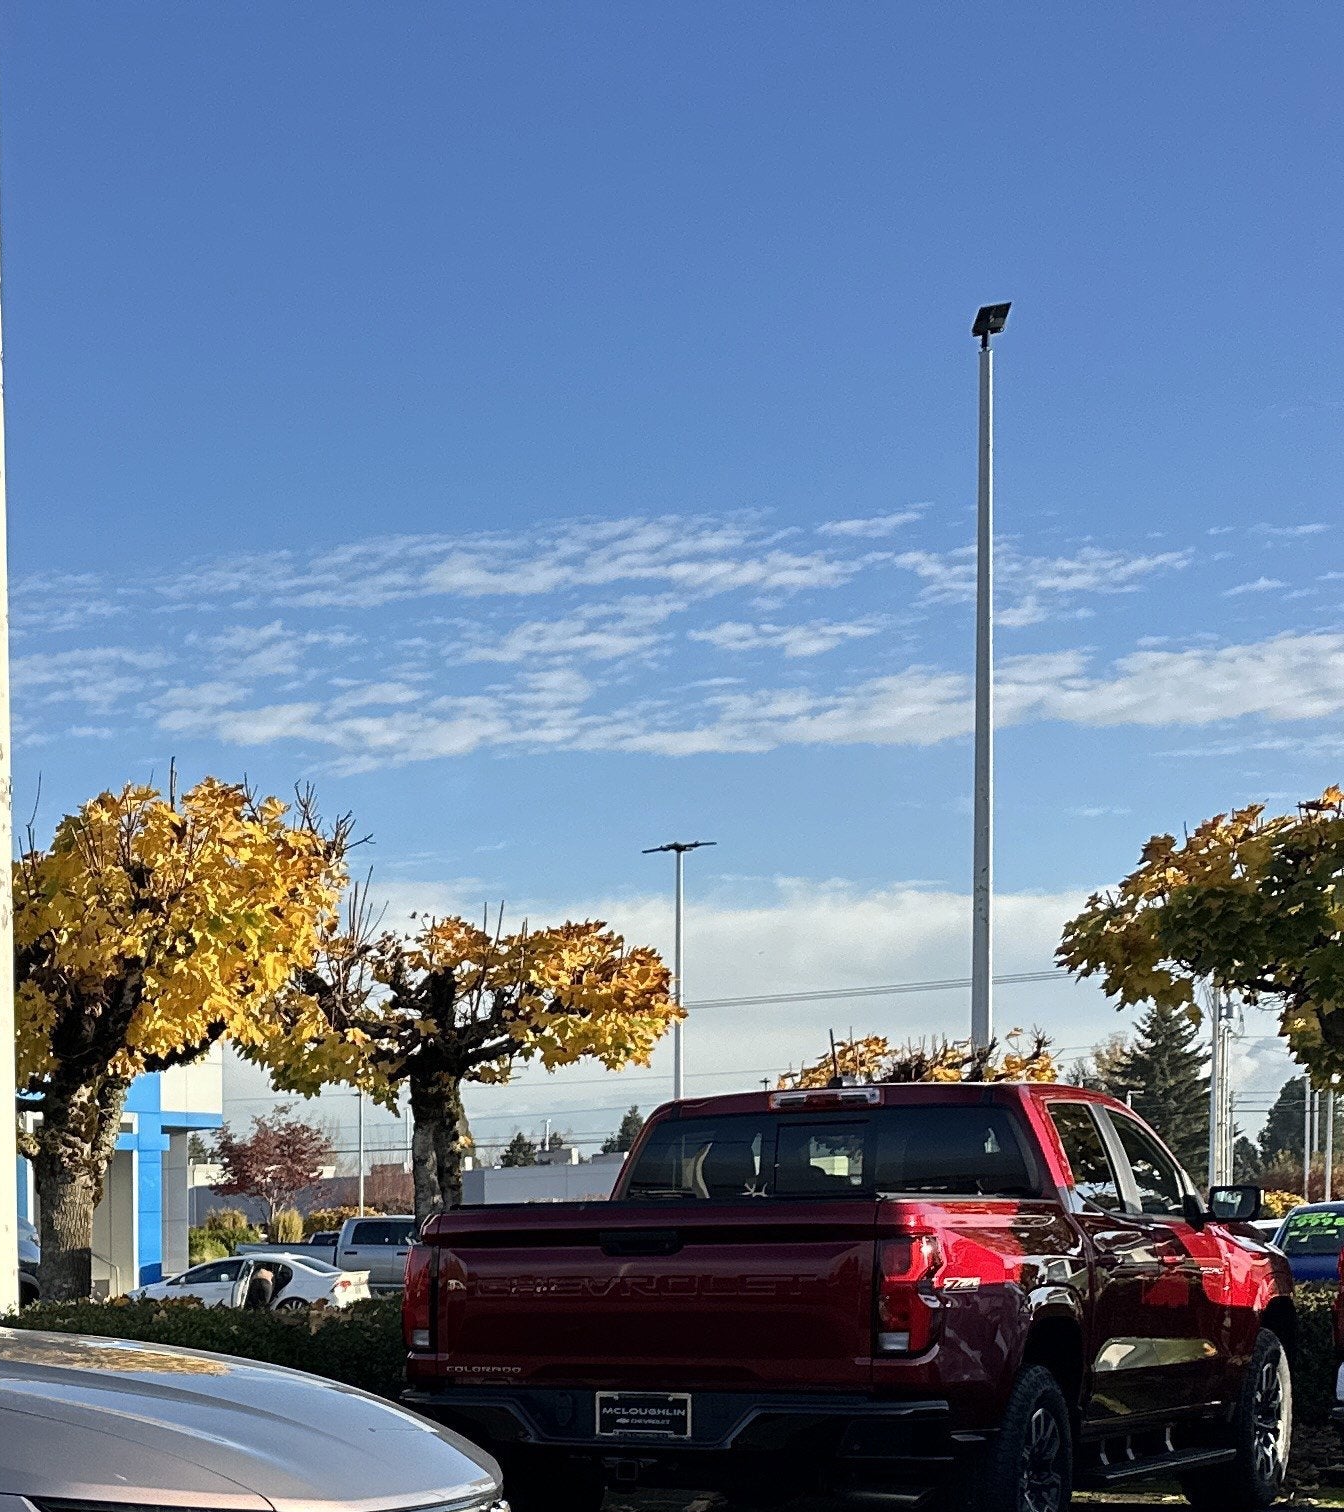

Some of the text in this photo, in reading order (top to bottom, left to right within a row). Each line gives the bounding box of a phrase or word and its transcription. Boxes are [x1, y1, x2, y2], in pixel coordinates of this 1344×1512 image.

[475, 1274, 817, 1297] CHEVROLET
[446, 1365, 522, 1373] COLORADO
[602, 1407, 686, 1416] MCLOUGHLIN
